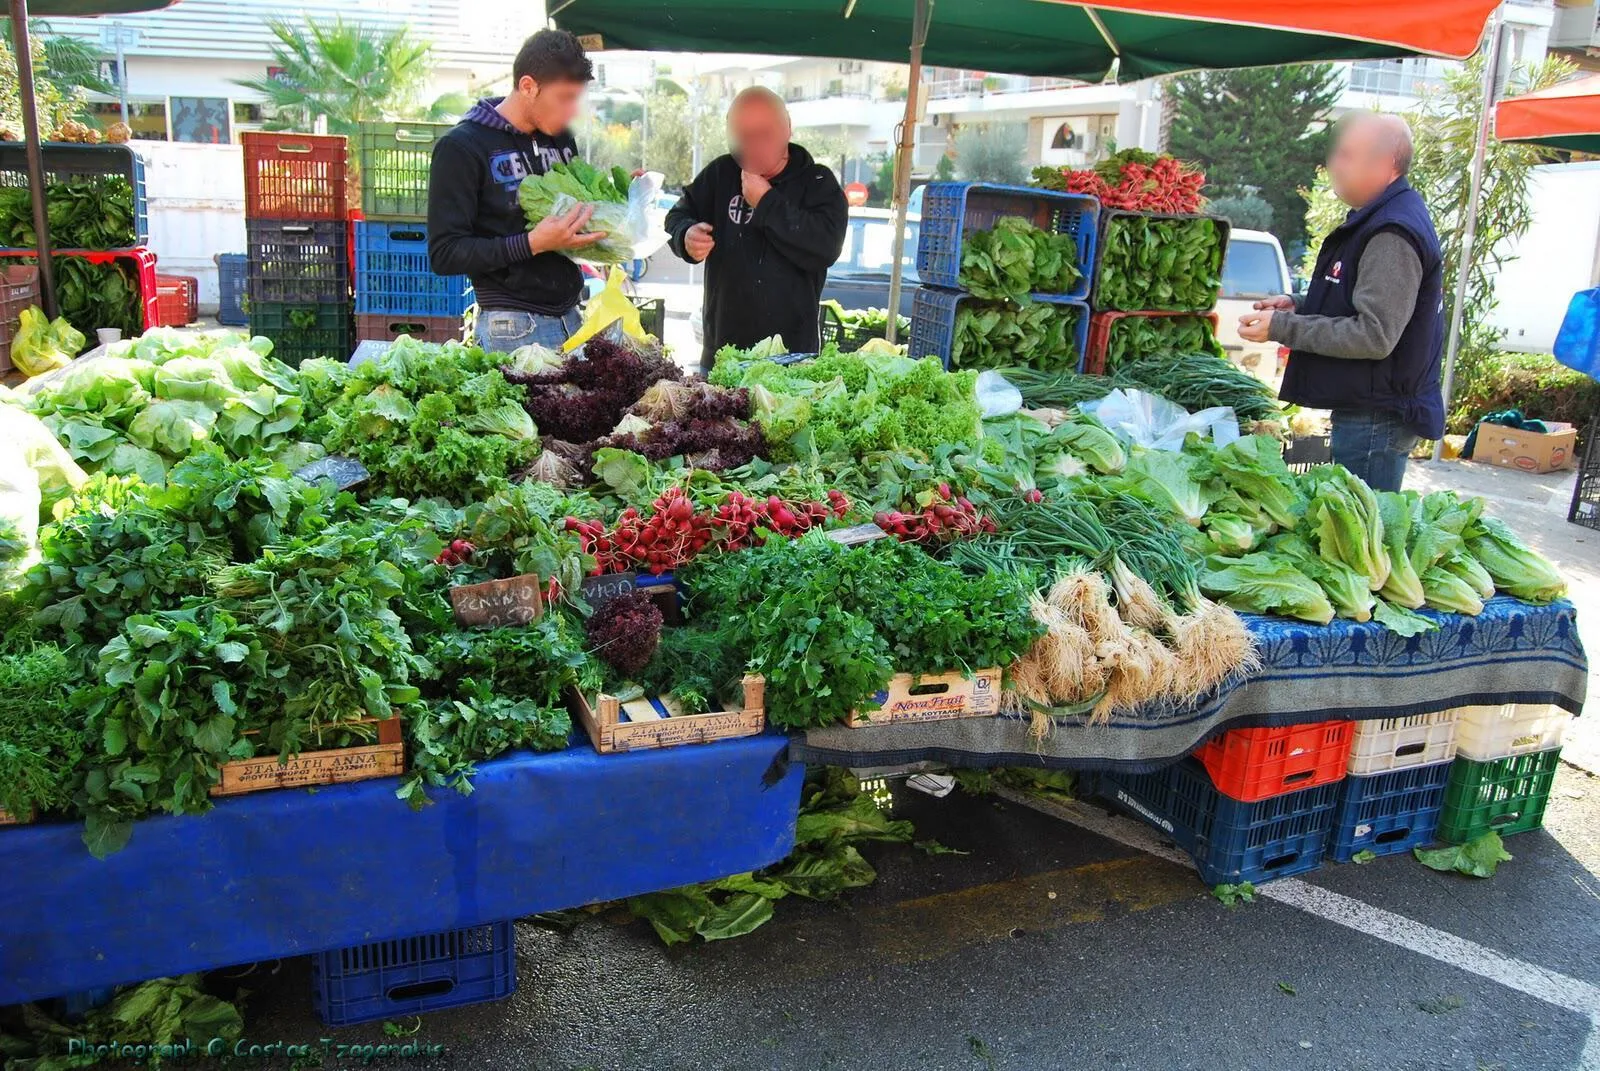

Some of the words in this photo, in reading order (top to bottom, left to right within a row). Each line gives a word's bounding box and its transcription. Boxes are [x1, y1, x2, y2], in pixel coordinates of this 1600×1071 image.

[894, 700, 929, 712] Nova
[930, 695, 966, 708] Fruit
[631, 721, 697, 736] ΣΤΑΜΑΤΗ
[704, 716, 742, 727] ΑΝΝΑ
[243, 758, 323, 775] ΣΤΑΜΑΤΗ
[333, 754, 377, 766] ΑΝΝΑ
